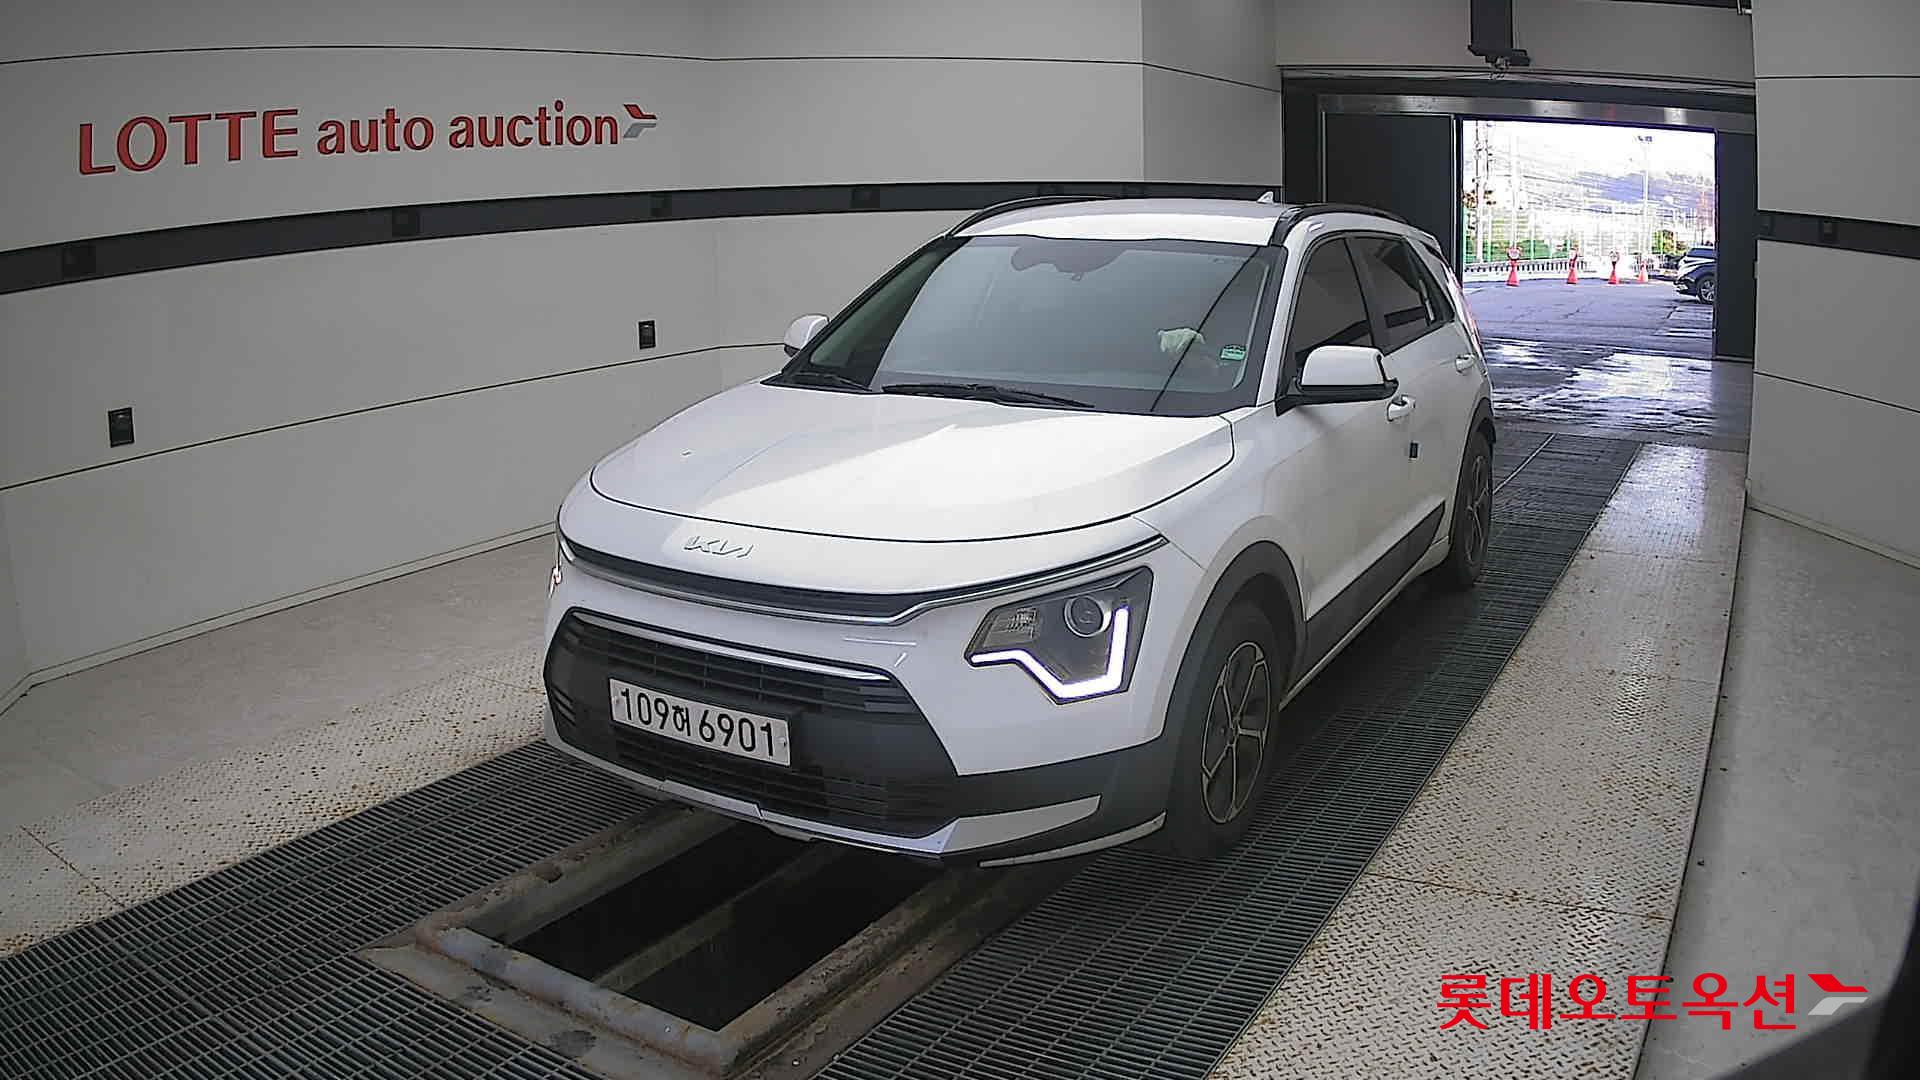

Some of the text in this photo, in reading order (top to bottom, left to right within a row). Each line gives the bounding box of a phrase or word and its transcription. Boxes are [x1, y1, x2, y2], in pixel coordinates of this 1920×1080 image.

[79, 99, 620, 175] LOTTE auto auction
[683, 535, 754, 558] KIA
